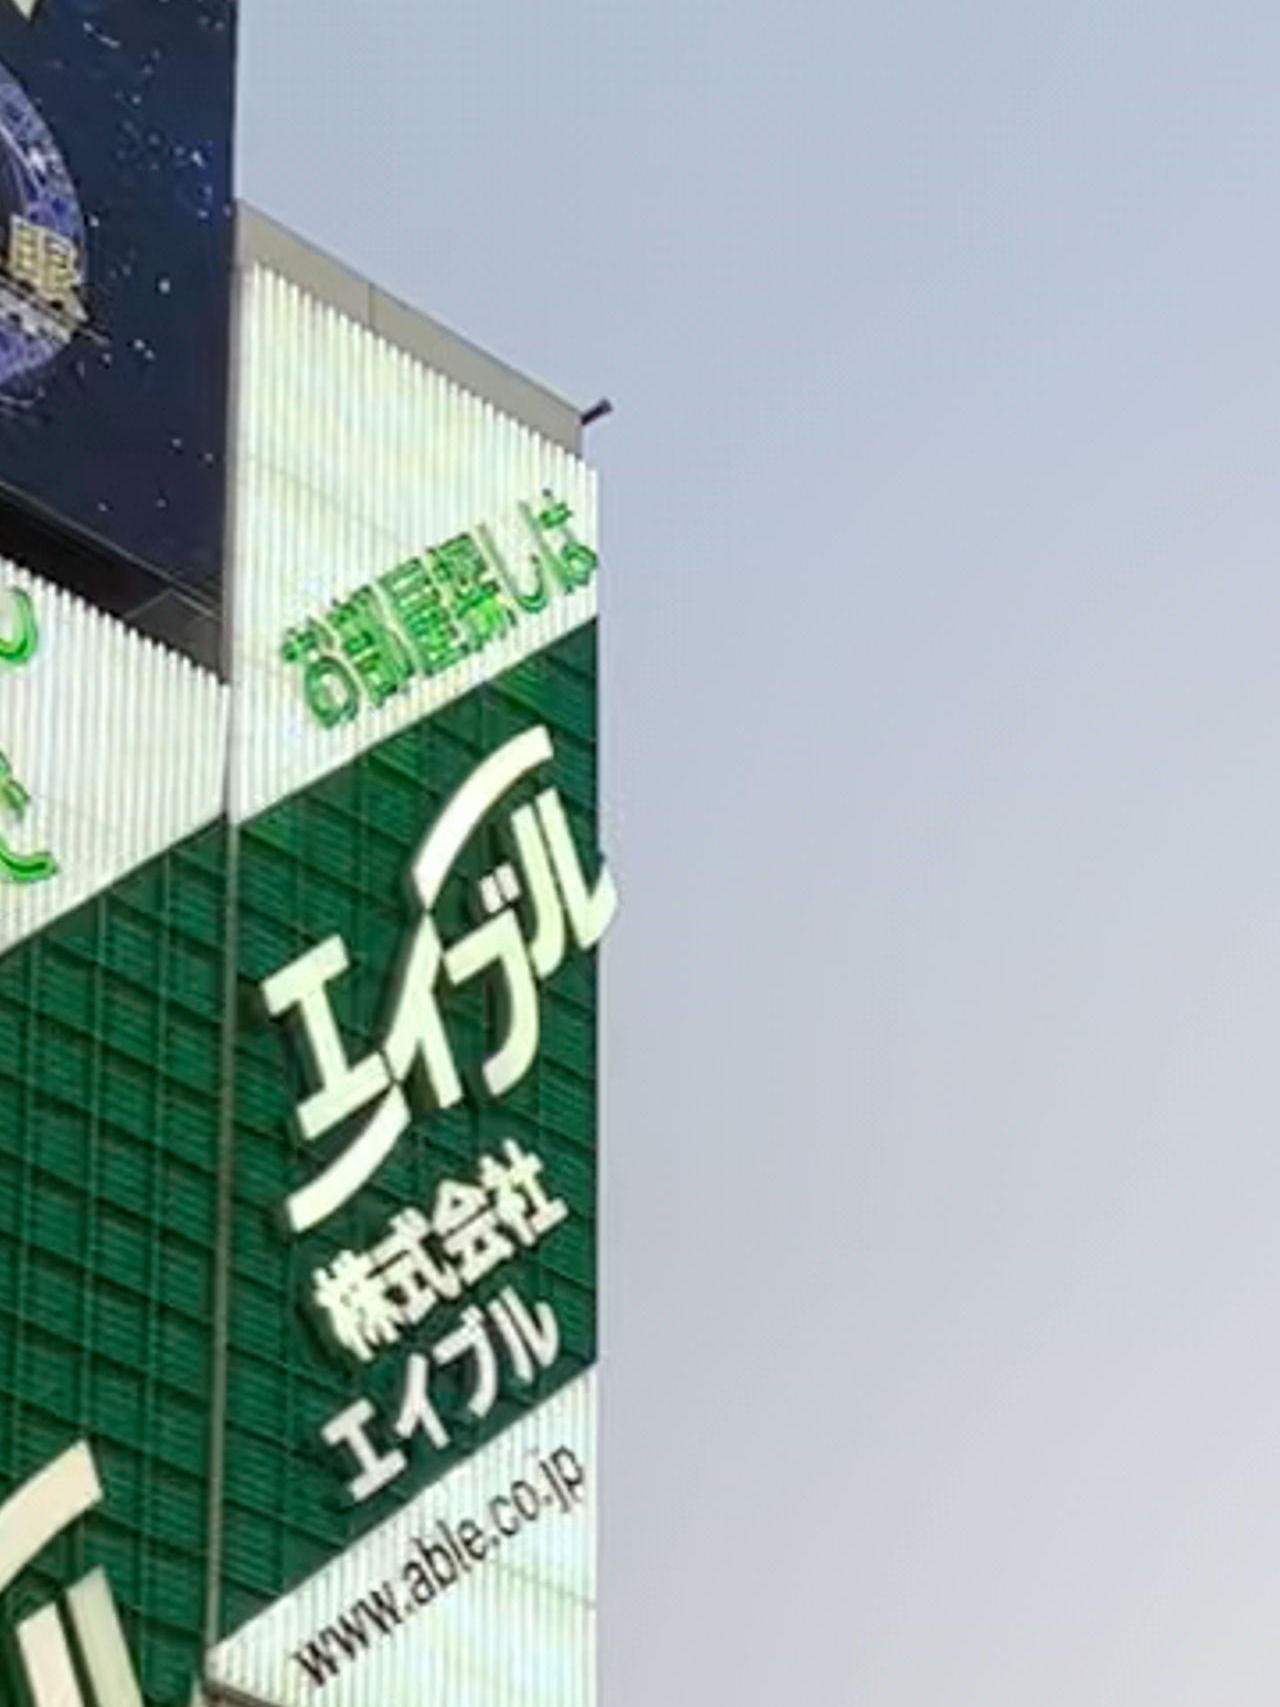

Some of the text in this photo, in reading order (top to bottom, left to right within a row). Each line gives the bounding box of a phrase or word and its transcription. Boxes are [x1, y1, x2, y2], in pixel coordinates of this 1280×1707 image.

[261, 724, 618, 1234] エイブル
[314, 1138, 568, 1361] 株式会社
[322, 1285, 560, 1501] エイブル
[294, 1445, 586, 1690] www.able.co.jp
